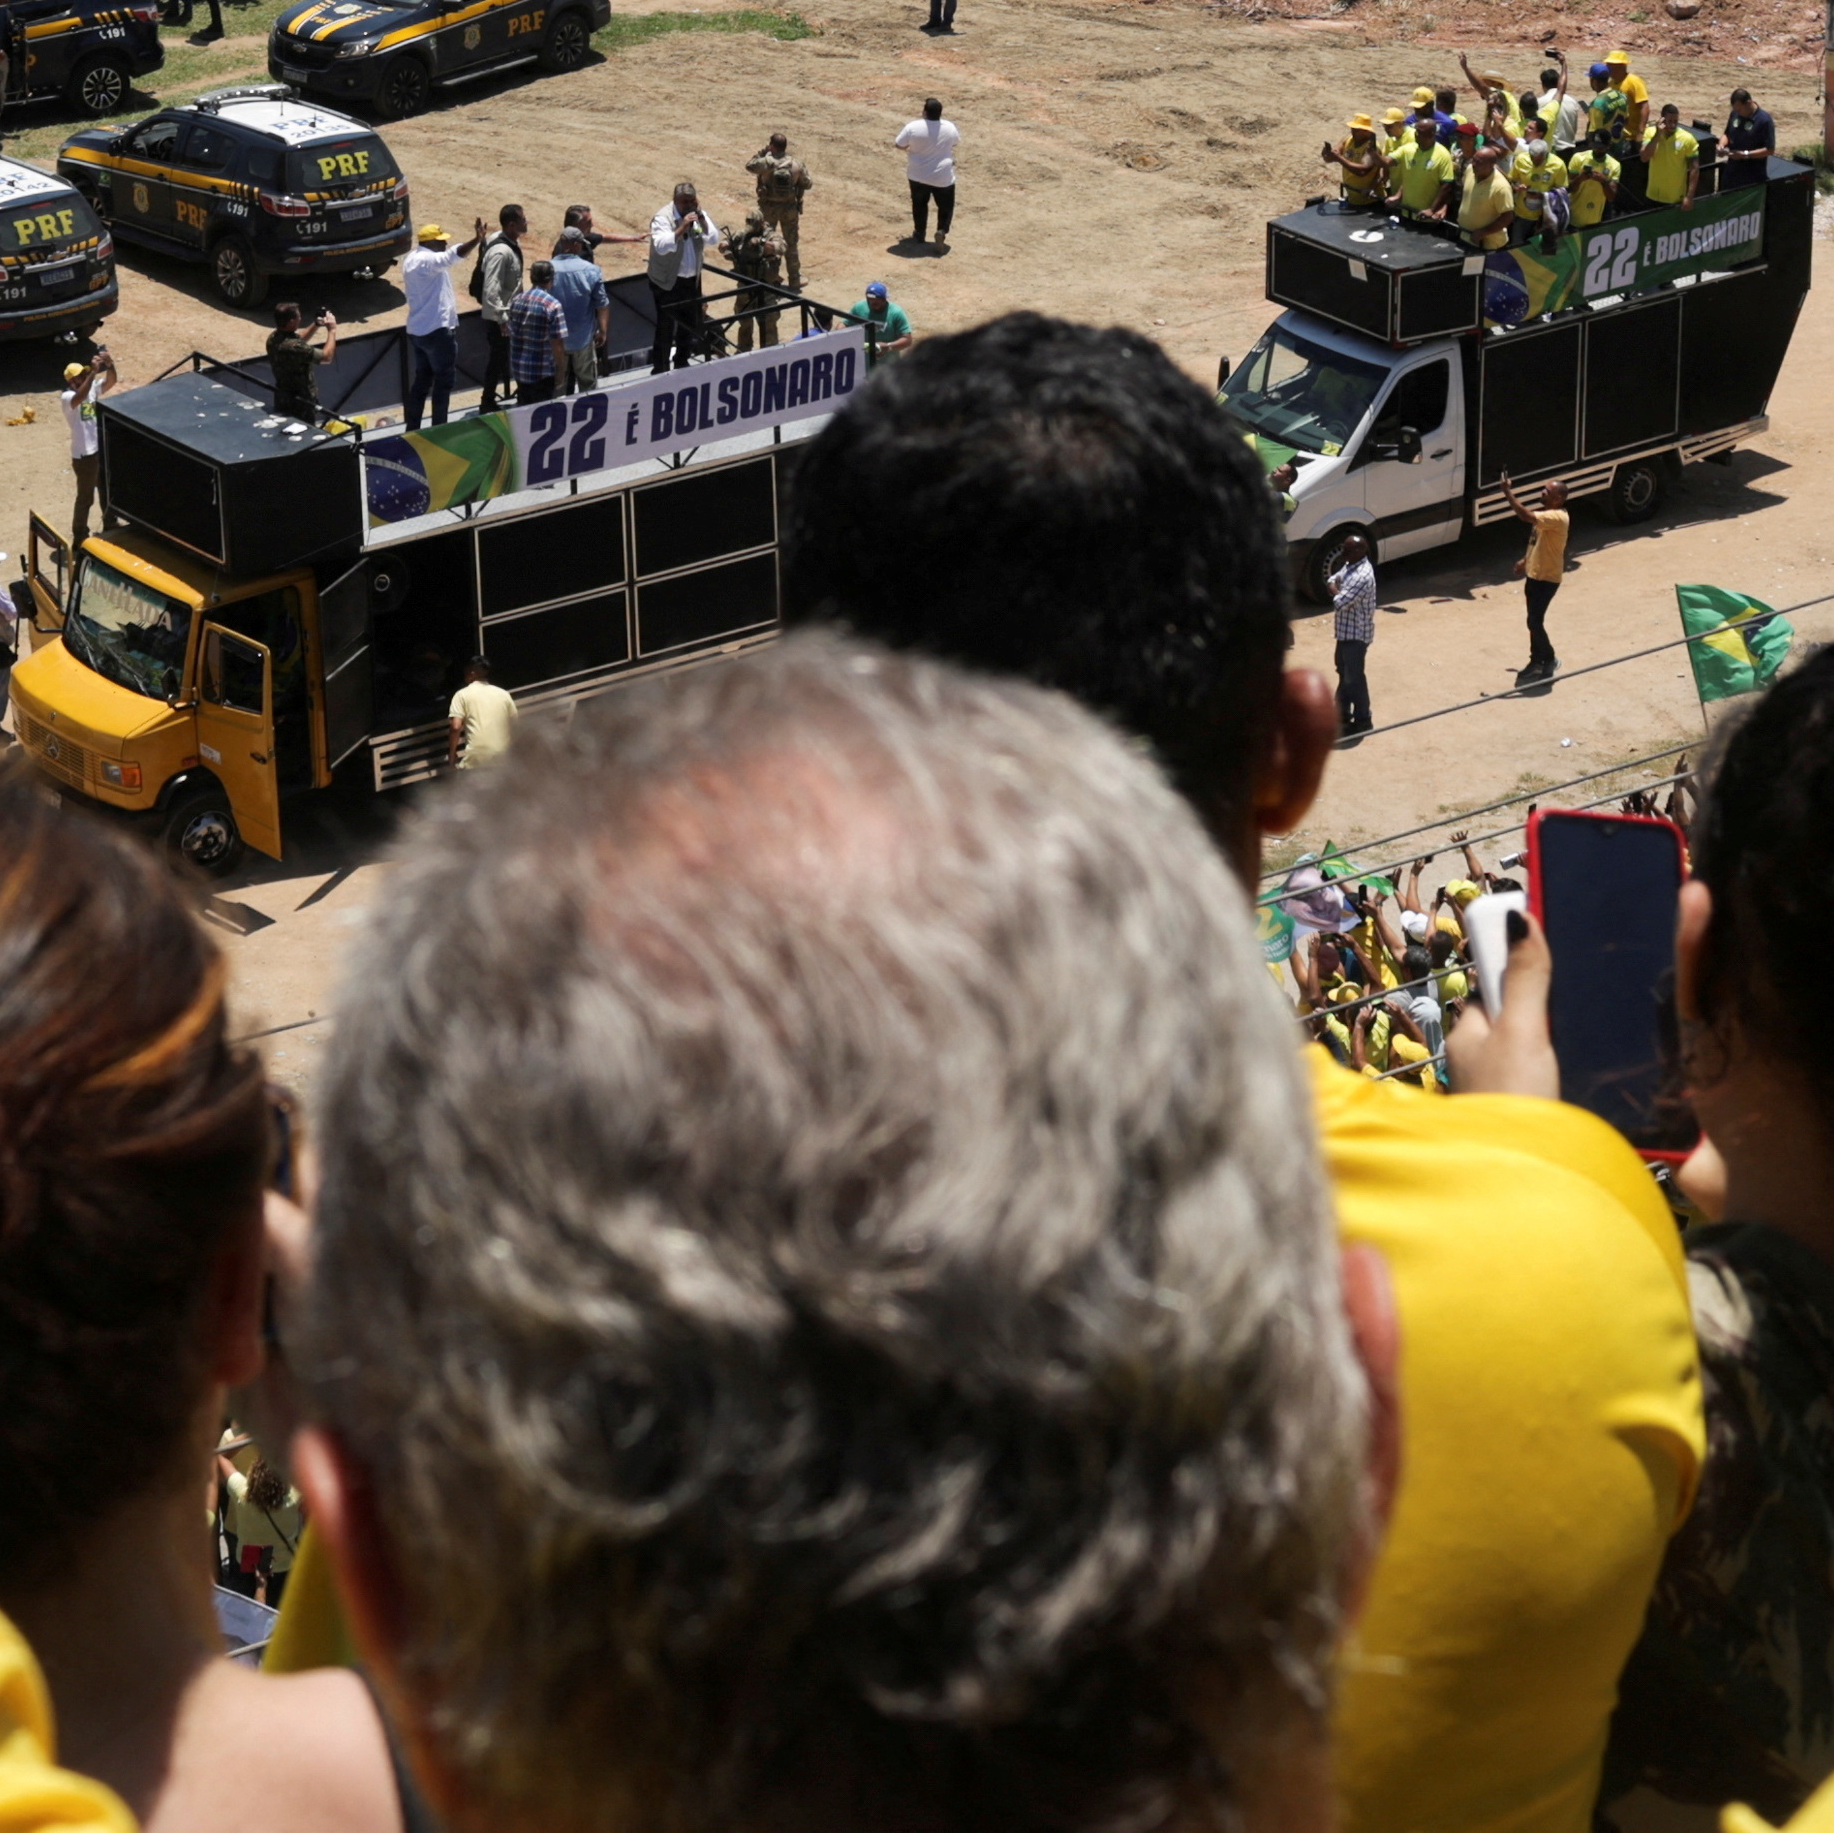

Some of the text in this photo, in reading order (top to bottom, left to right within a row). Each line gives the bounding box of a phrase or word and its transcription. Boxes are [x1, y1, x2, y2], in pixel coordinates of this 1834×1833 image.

[106, 26, 125, 39] 191
[508, 9, 545, 38] PRF
[317, 151, 370, 181] PRF
[176, 200, 208, 232] PRF
[233, 204, 249, 218] 191
[13, 209, 74, 245] PRF
[304, 222, 328, 234] 191
[1583, 226, 1640, 297] 22
[1643, 240, 1652, 267] É
[1655, 212, 1761, 265] BOLSONARO
[3, 286, 27, 301] 191
[526, 346, 856, 486] 22 É BOLSONARO
